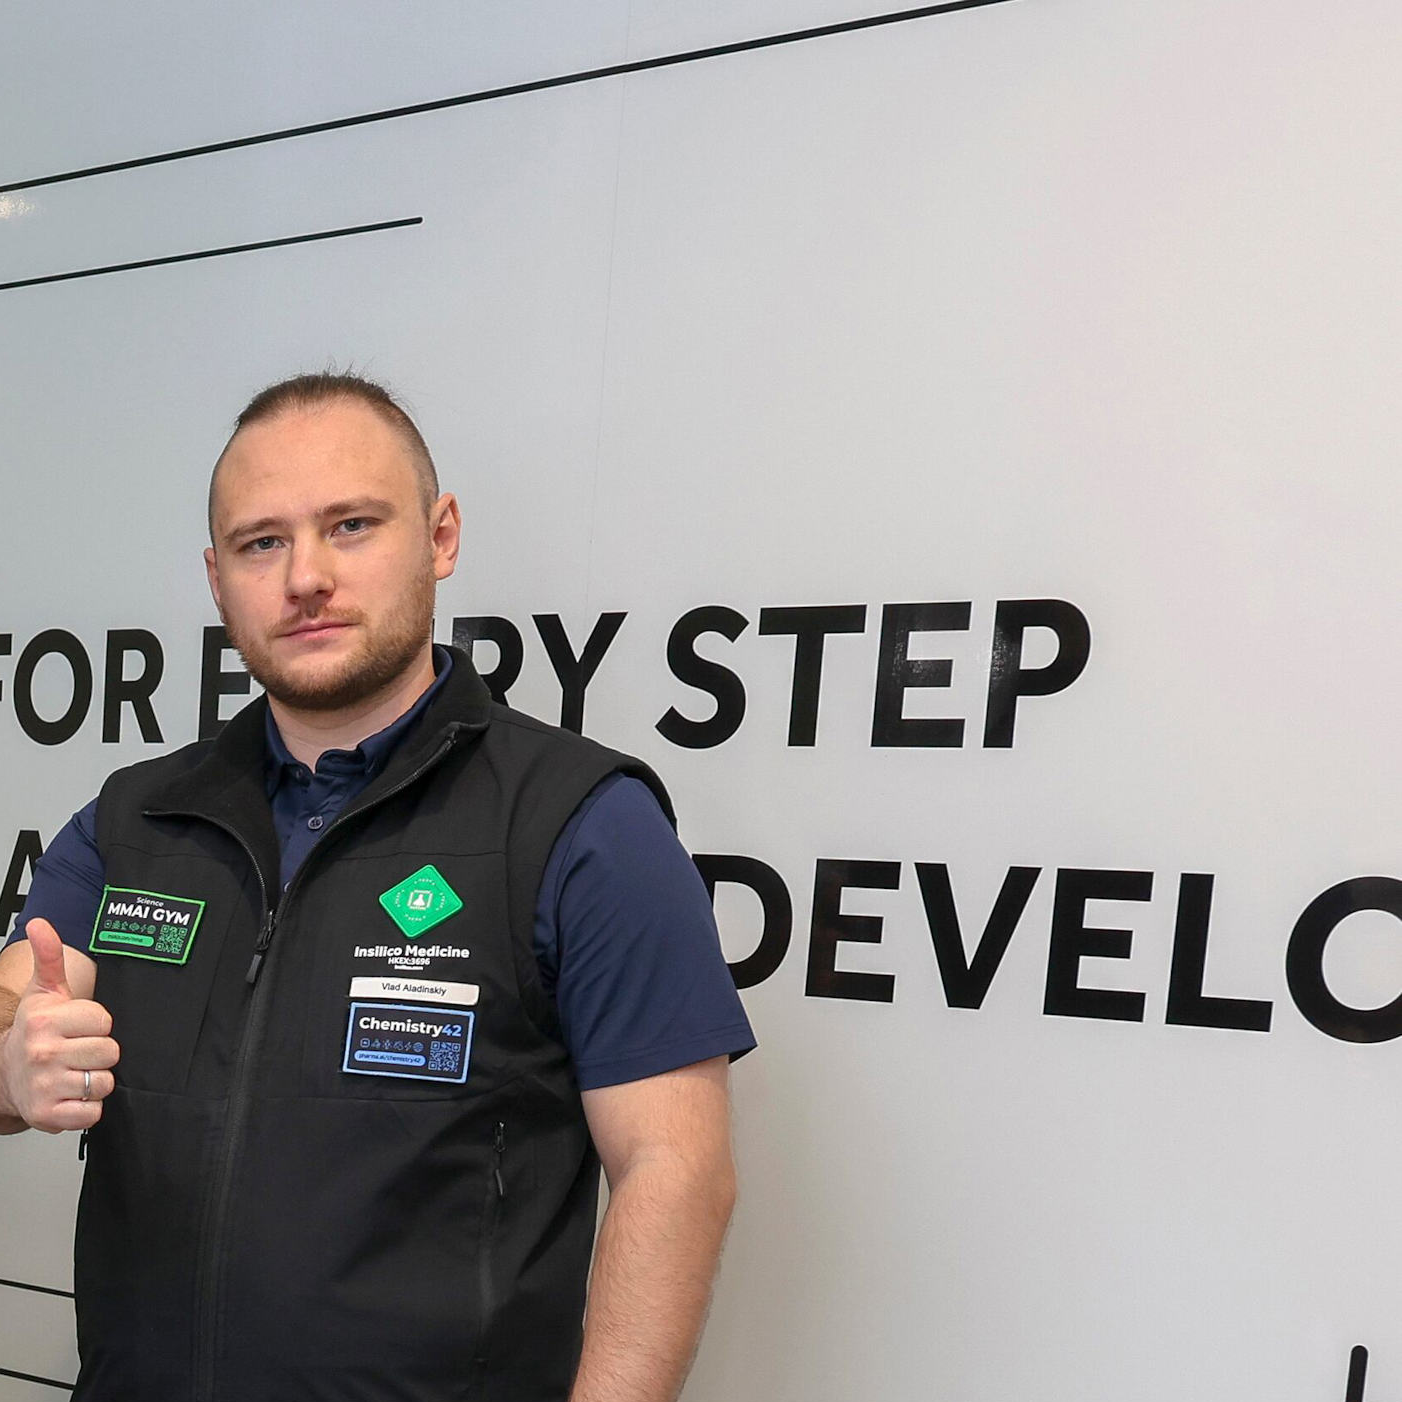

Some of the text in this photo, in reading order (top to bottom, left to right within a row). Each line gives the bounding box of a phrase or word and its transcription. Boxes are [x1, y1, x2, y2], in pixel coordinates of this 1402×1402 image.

[198, 611, 628, 742] ERY
[655, 599, 1091, 749] STEP
[136, 896, 164, 907] Science
[108, 902, 191, 926] MMAI GYM
[354, 945, 470, 958] Insilico Medicine
[382, 983, 401, 991] Vlad
[359, 1017, 462, 1038] Chemistry42
